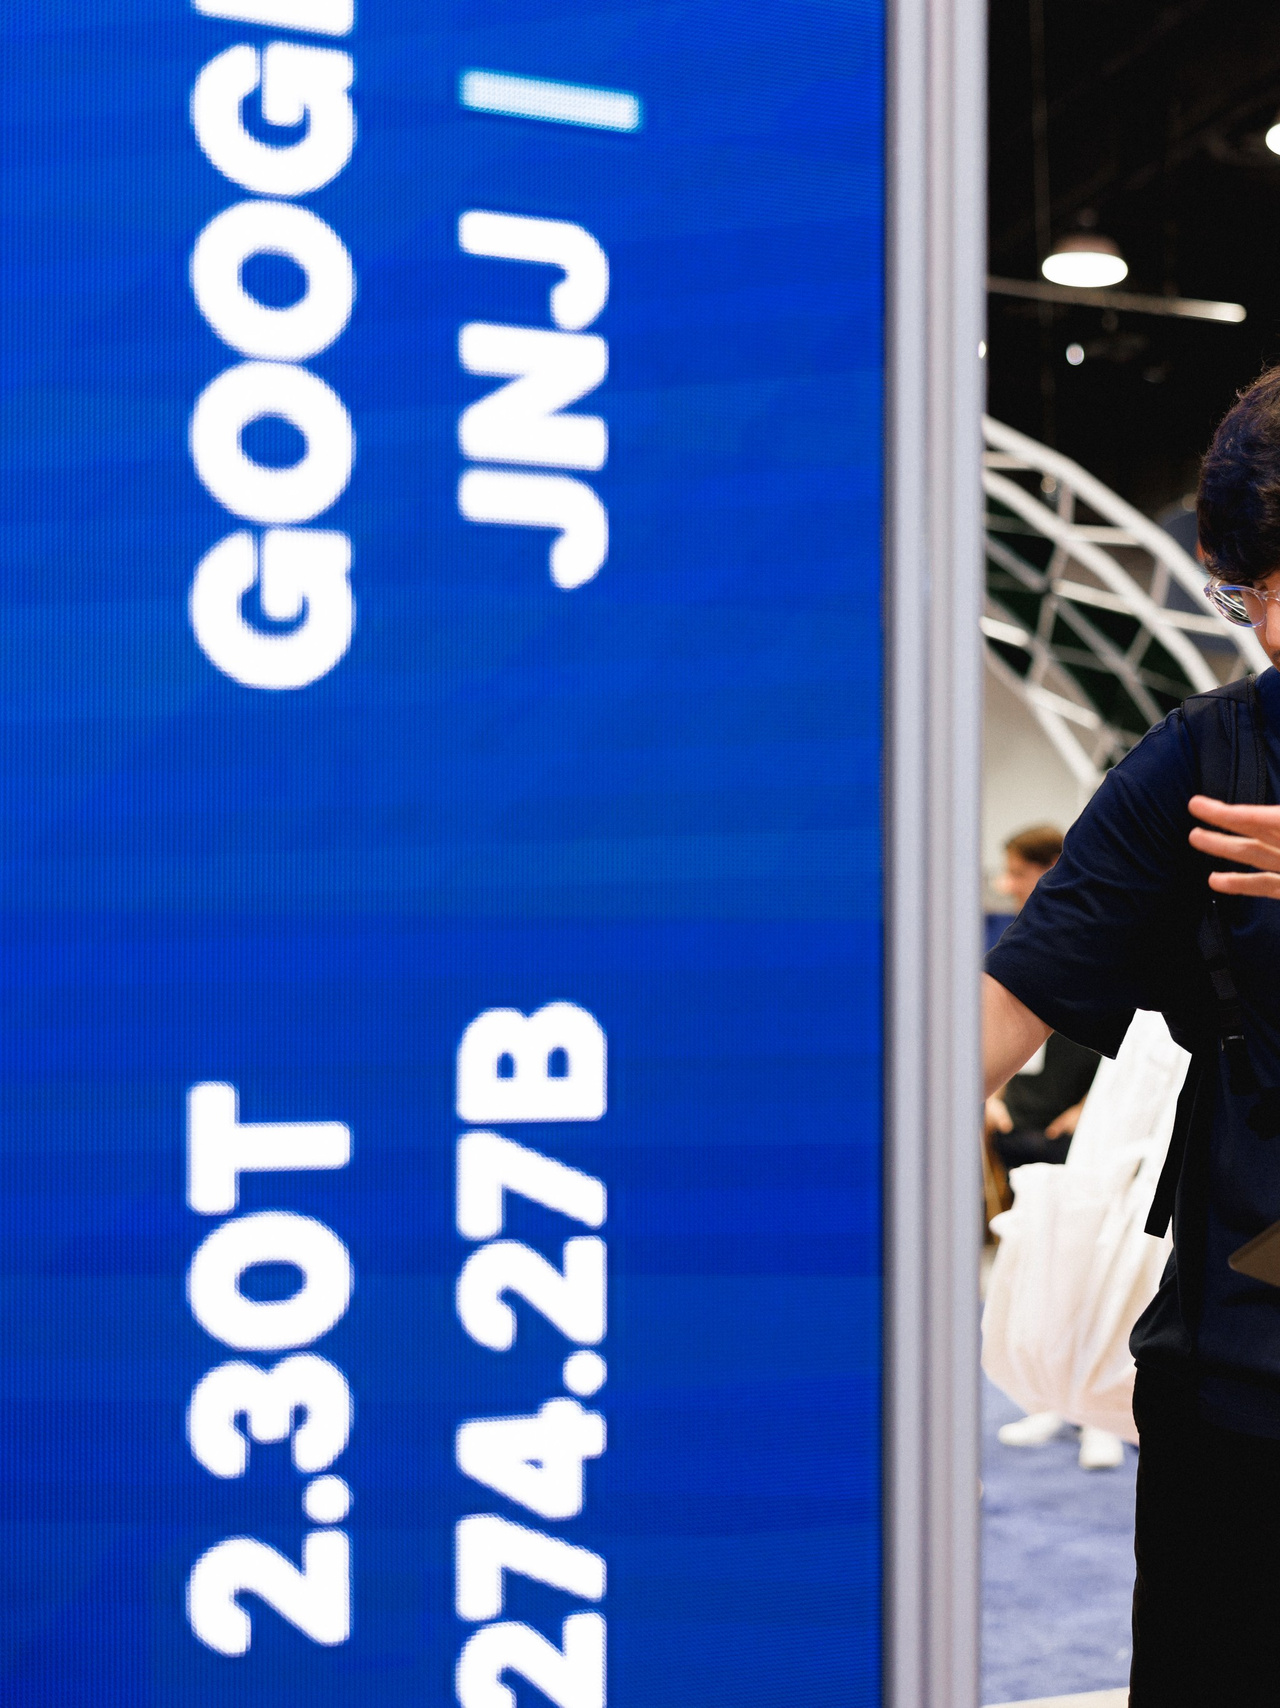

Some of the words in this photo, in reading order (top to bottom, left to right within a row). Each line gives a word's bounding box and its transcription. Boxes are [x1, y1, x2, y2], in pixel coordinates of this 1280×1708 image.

[457, 210, 610, 589] JNJ
[187, 1081, 355, 1656] 2.30T
[456, 1001, 608, 1708] 274.27B
